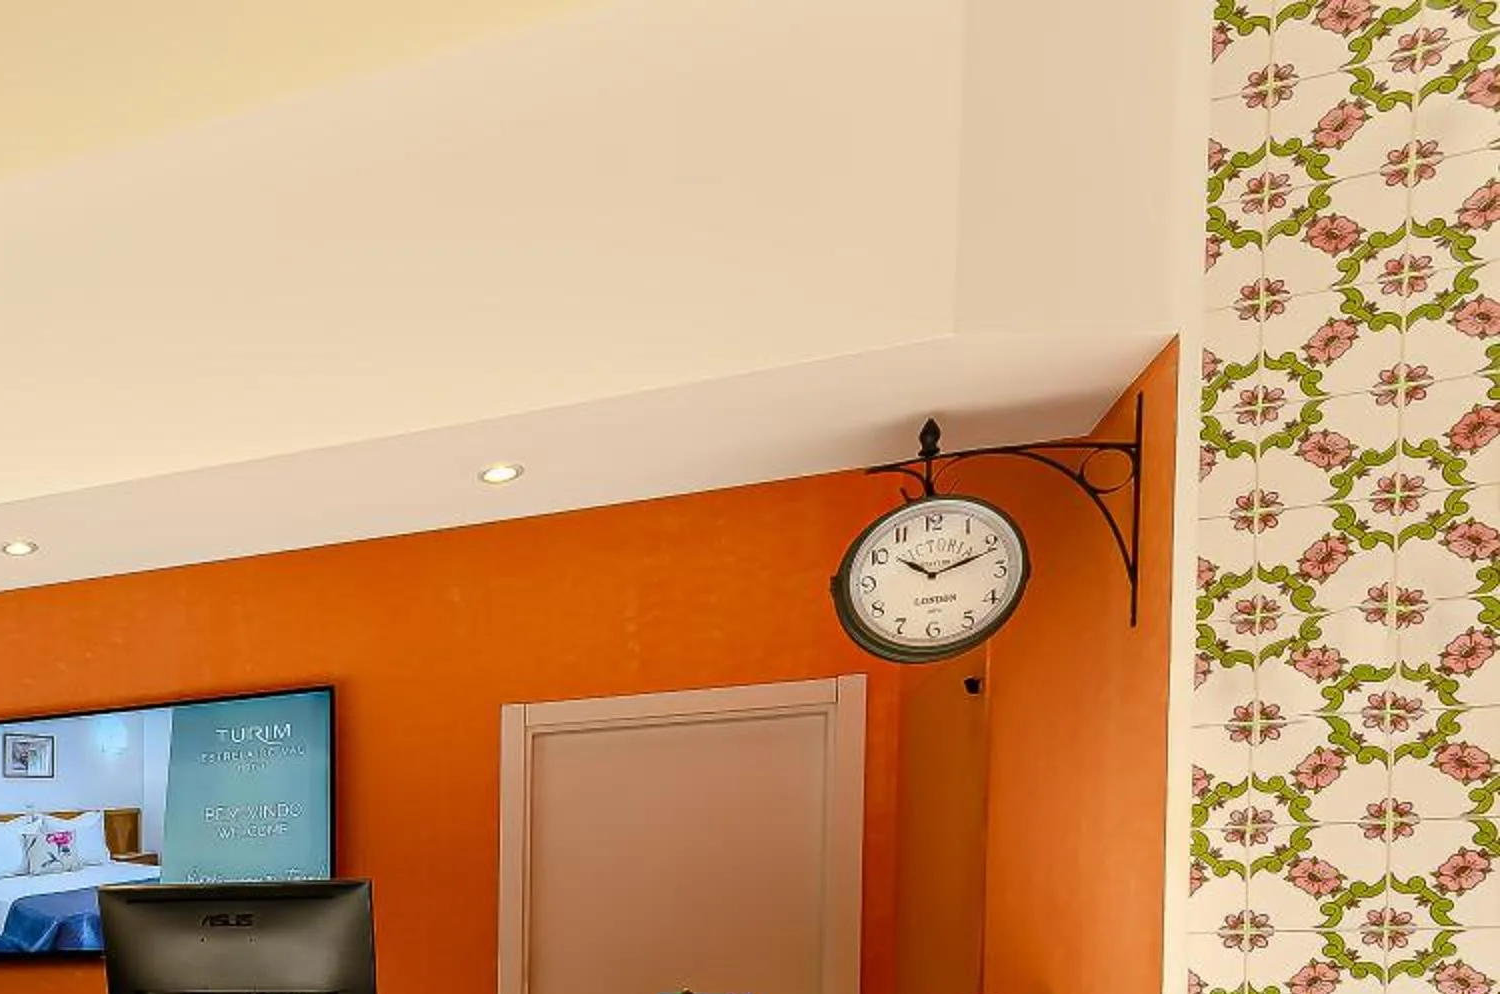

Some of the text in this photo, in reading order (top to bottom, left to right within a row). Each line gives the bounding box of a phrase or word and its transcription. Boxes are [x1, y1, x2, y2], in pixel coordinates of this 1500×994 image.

[925, 513, 943, 532] 12
[965, 515, 973, 535] 1
[894, 525, 907, 544] 11
[985, 534, 998, 551] 2
[871, 548, 889, 566] 10
[993, 560, 1007, 578] 3
[861, 575, 877, 593] 9
[915, 594, 957, 606] LONDON
[982, 589, 1001, 604] 4
[871, 600, 885, 618] 8
[894, 617, 907, 635] 7
[961, 610, 975, 629] 5
[925, 621, 941, 639] 6
[215, 722, 292, 745] TURIM
[217, 823, 289, 840] WECOME
[201, 913, 253, 927] ASUS
